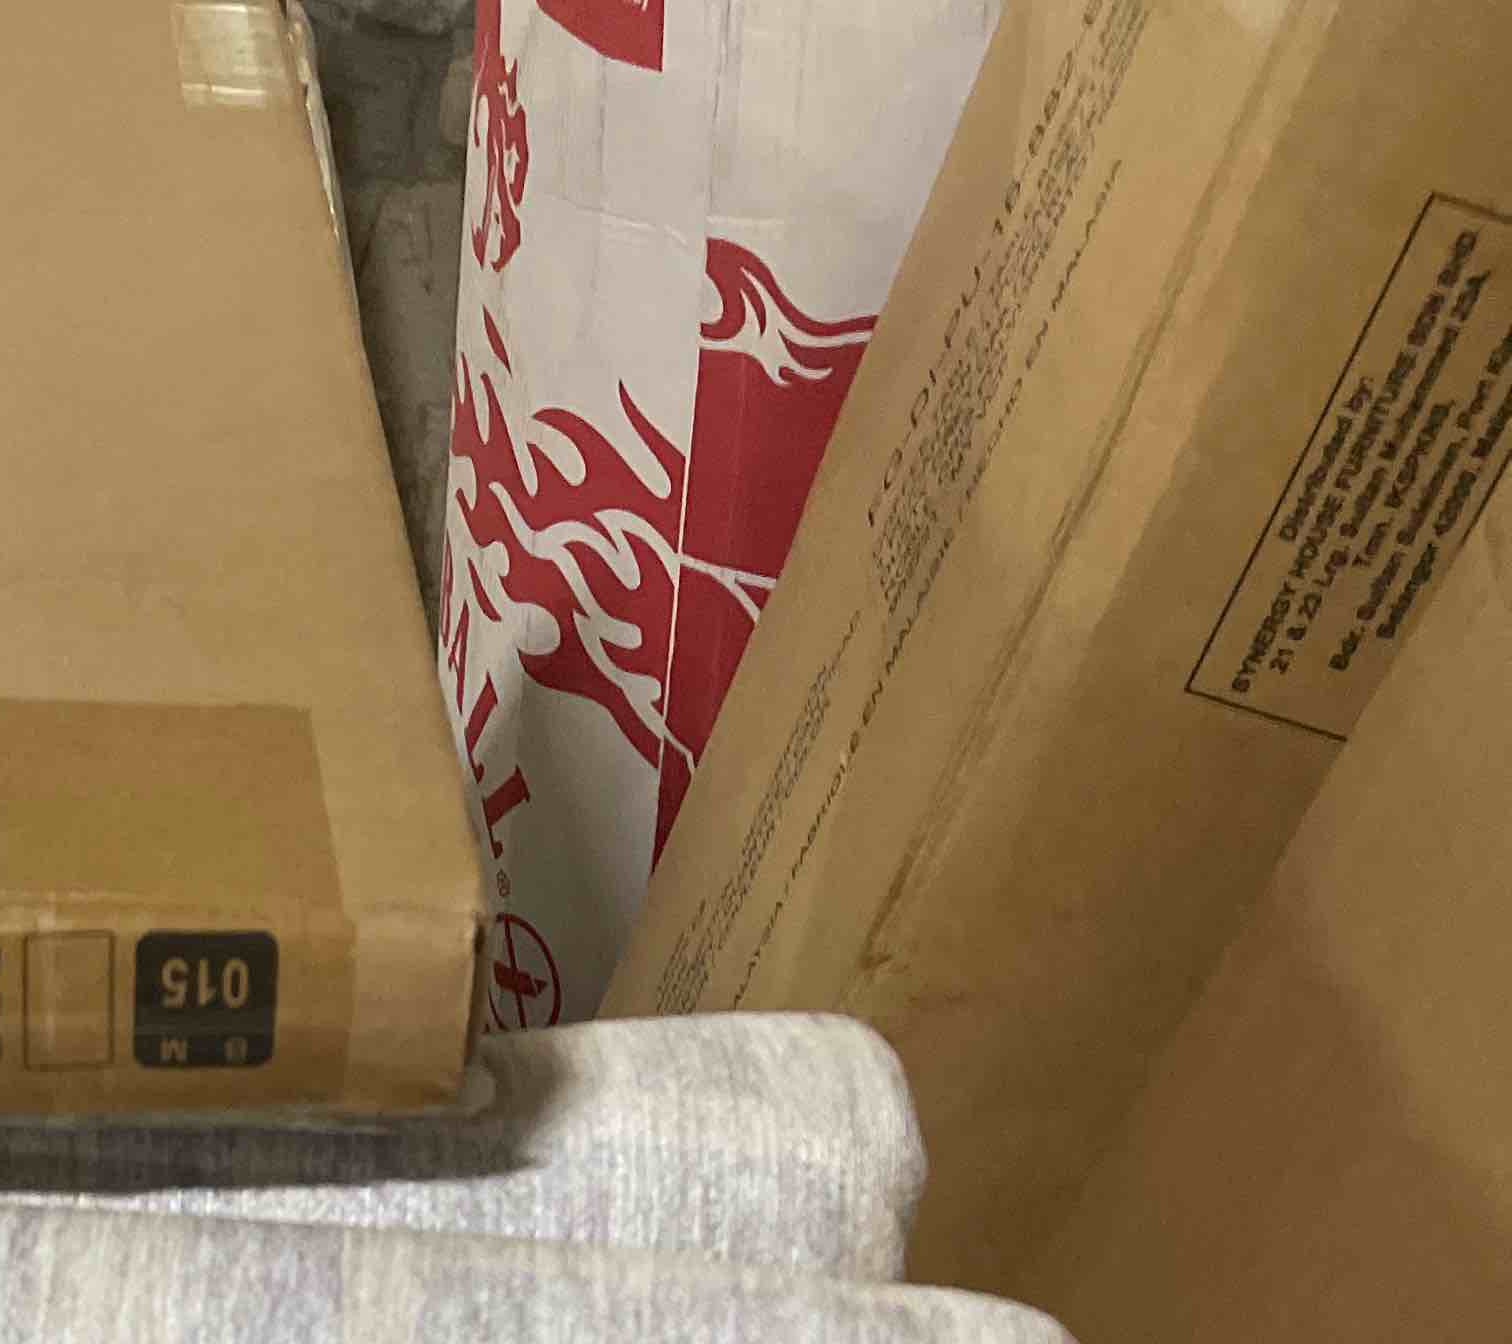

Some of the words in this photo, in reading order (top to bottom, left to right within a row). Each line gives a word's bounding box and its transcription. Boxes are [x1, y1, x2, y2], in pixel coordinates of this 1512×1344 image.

[1231, 581, 1298, 692] SYNERGY
[1288, 495, 1344, 578] HOUSE
[159, 956, 248, 1007] 015
